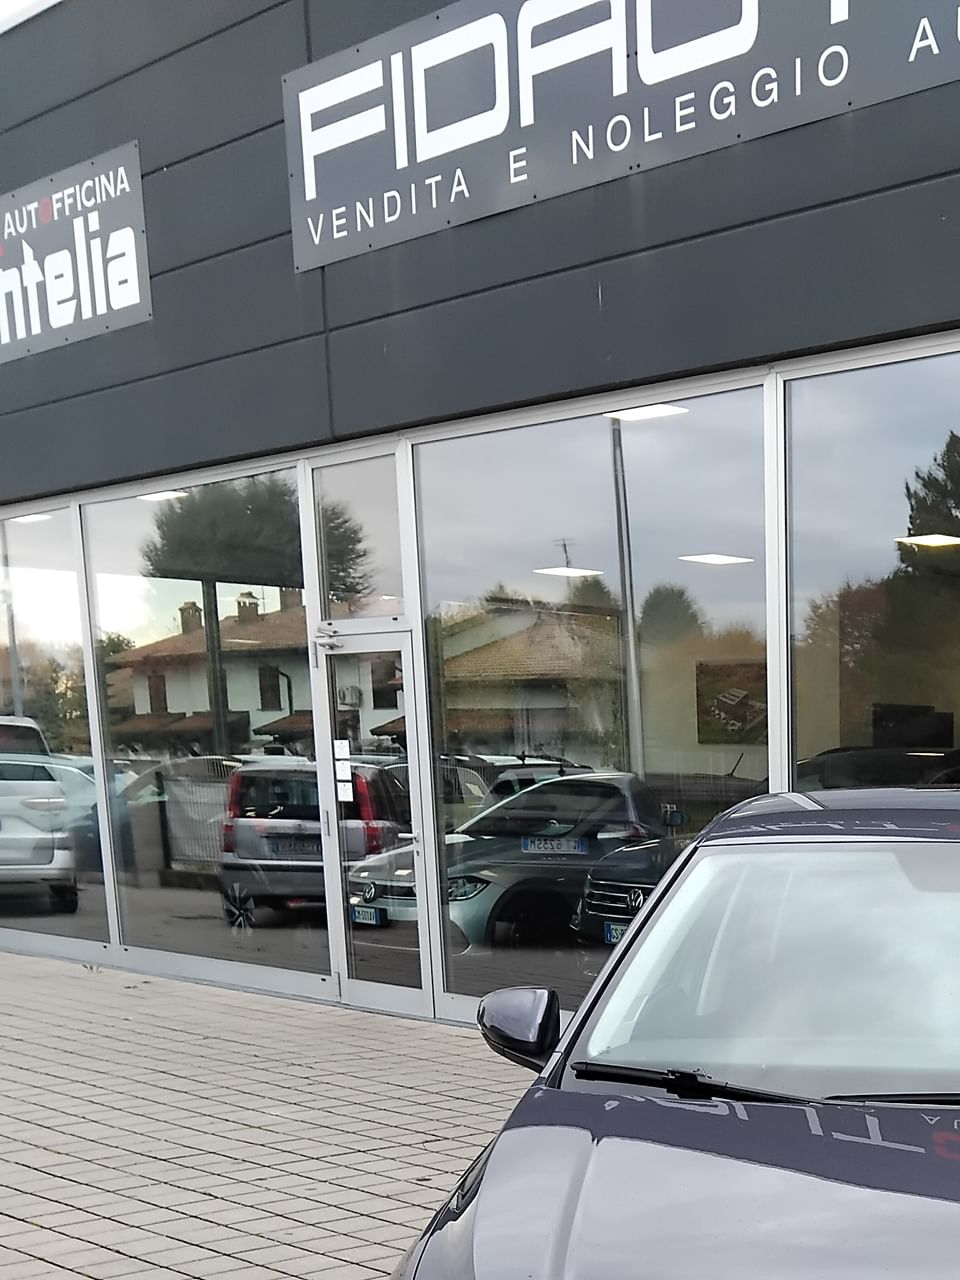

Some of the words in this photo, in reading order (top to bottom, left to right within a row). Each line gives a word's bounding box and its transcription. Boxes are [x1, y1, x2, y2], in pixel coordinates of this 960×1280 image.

[298, 0, 849, 201] FIDAU
[307, 167, 470, 246] VENDITA
[508, 145, 529, 184] E
[571, 44, 849, 165] NOLEGGIO
[0, 210, 141, 345] ntelia
[3, 166, 131, 240] AUTOFFICINA
